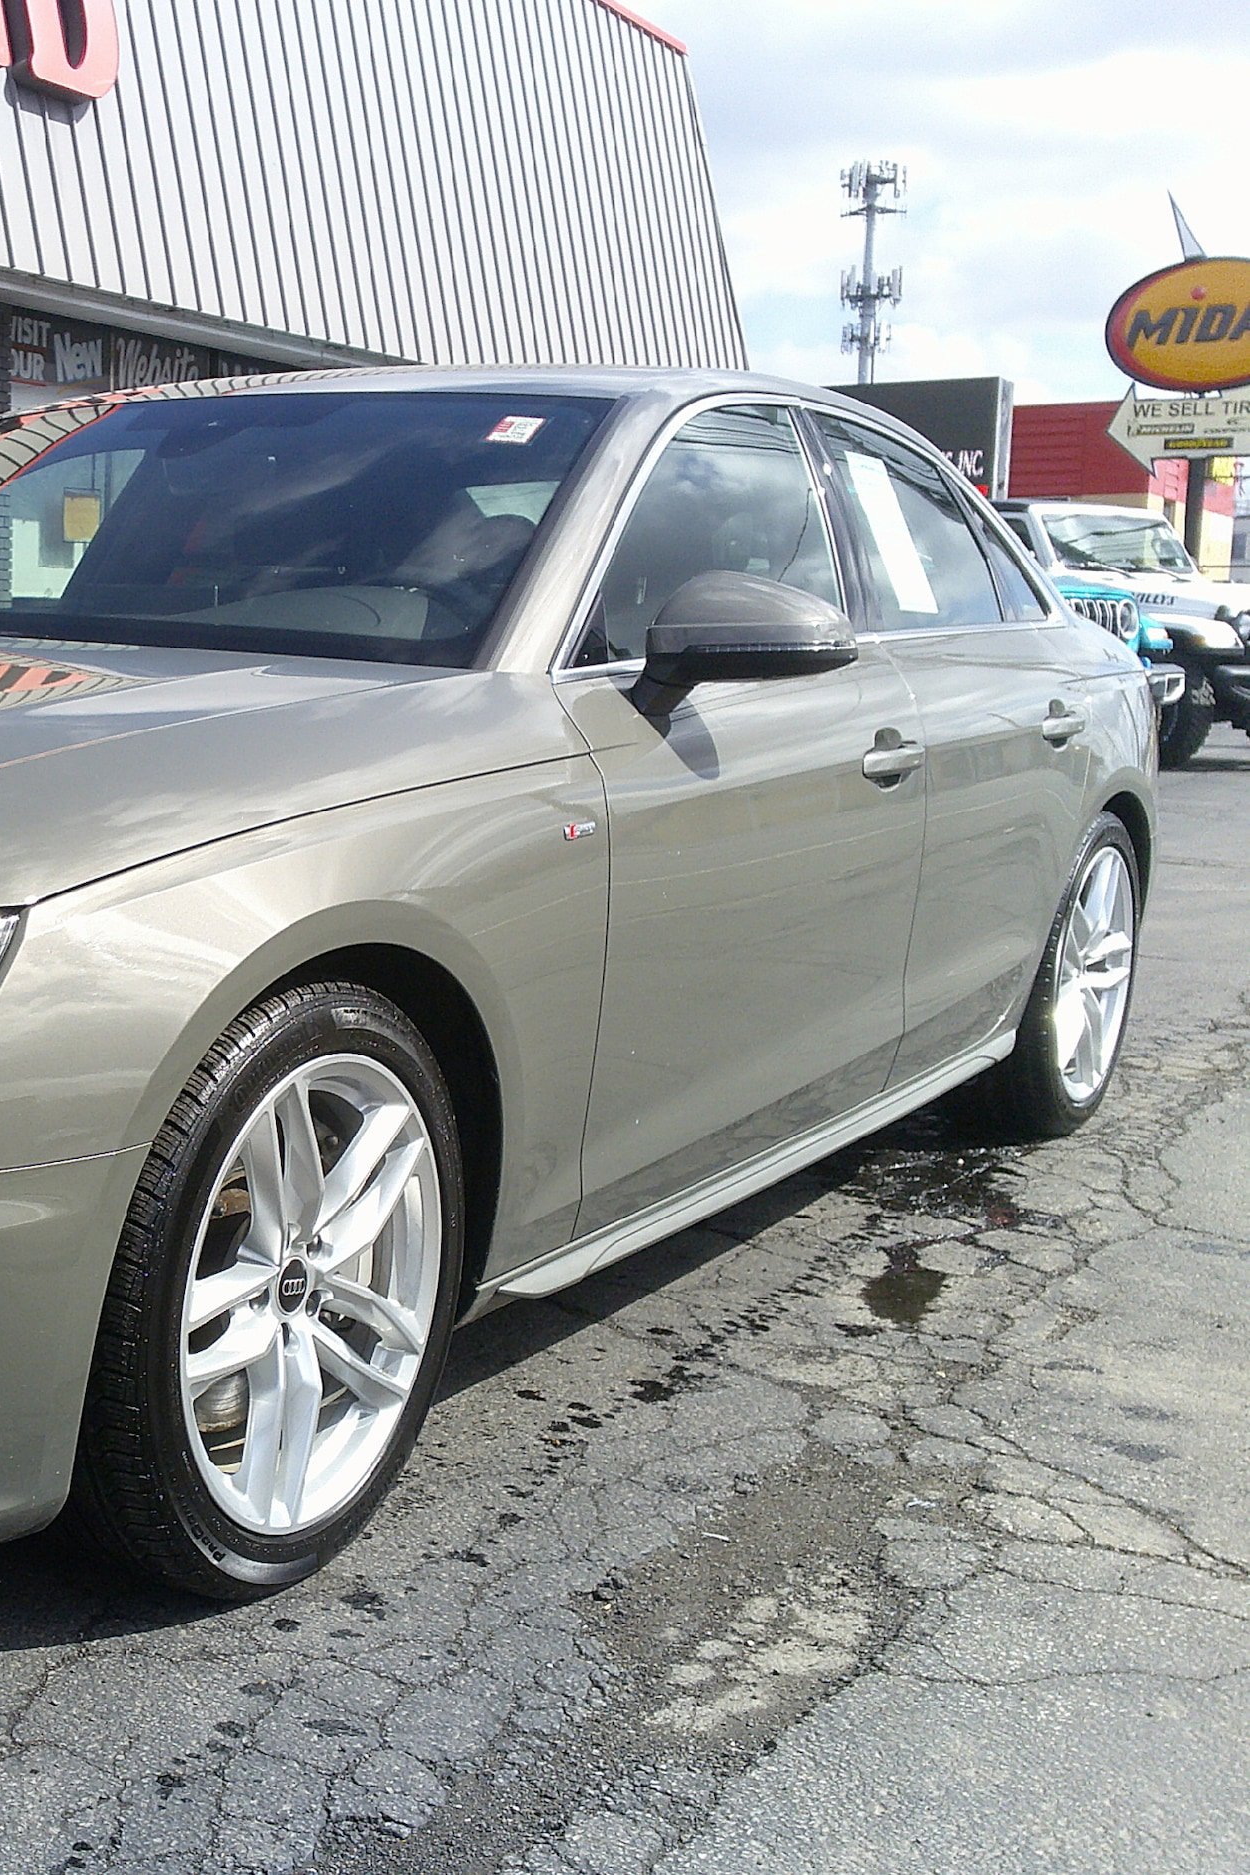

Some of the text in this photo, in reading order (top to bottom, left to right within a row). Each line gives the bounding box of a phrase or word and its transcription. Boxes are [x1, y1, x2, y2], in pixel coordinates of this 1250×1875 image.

[54, 333, 102, 382] New
[1133, 402, 1163, 418] WE
[1168, 401, 1215, 418] SELL
